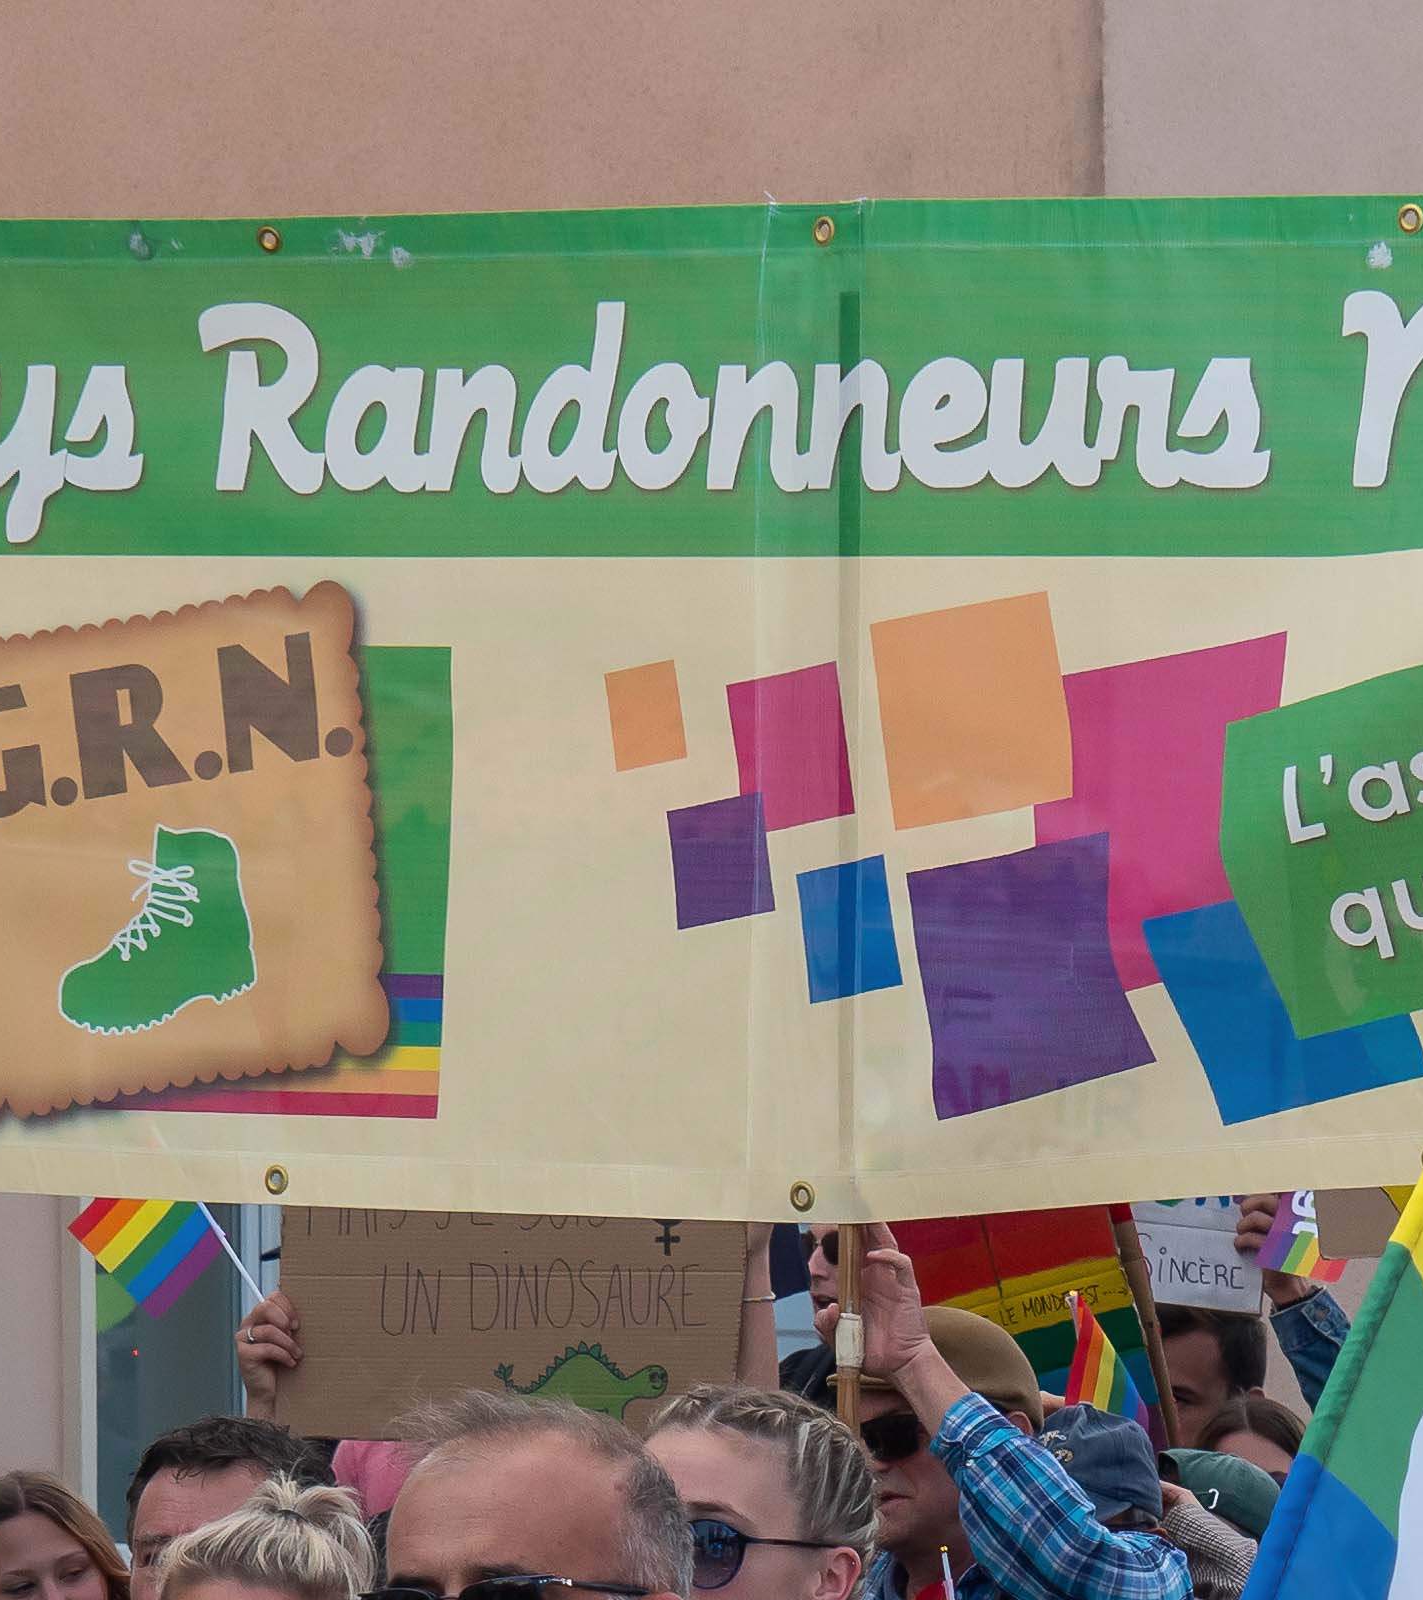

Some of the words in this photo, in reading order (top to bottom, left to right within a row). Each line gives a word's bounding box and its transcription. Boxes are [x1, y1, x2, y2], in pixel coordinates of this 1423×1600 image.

[197, 301, 1272, 495] Randonneurs
[379, 1261, 441, 1337] UN
[469, 1253, 707, 1332] DINOSAURE
[999, 1307, 1019, 1327] LE
